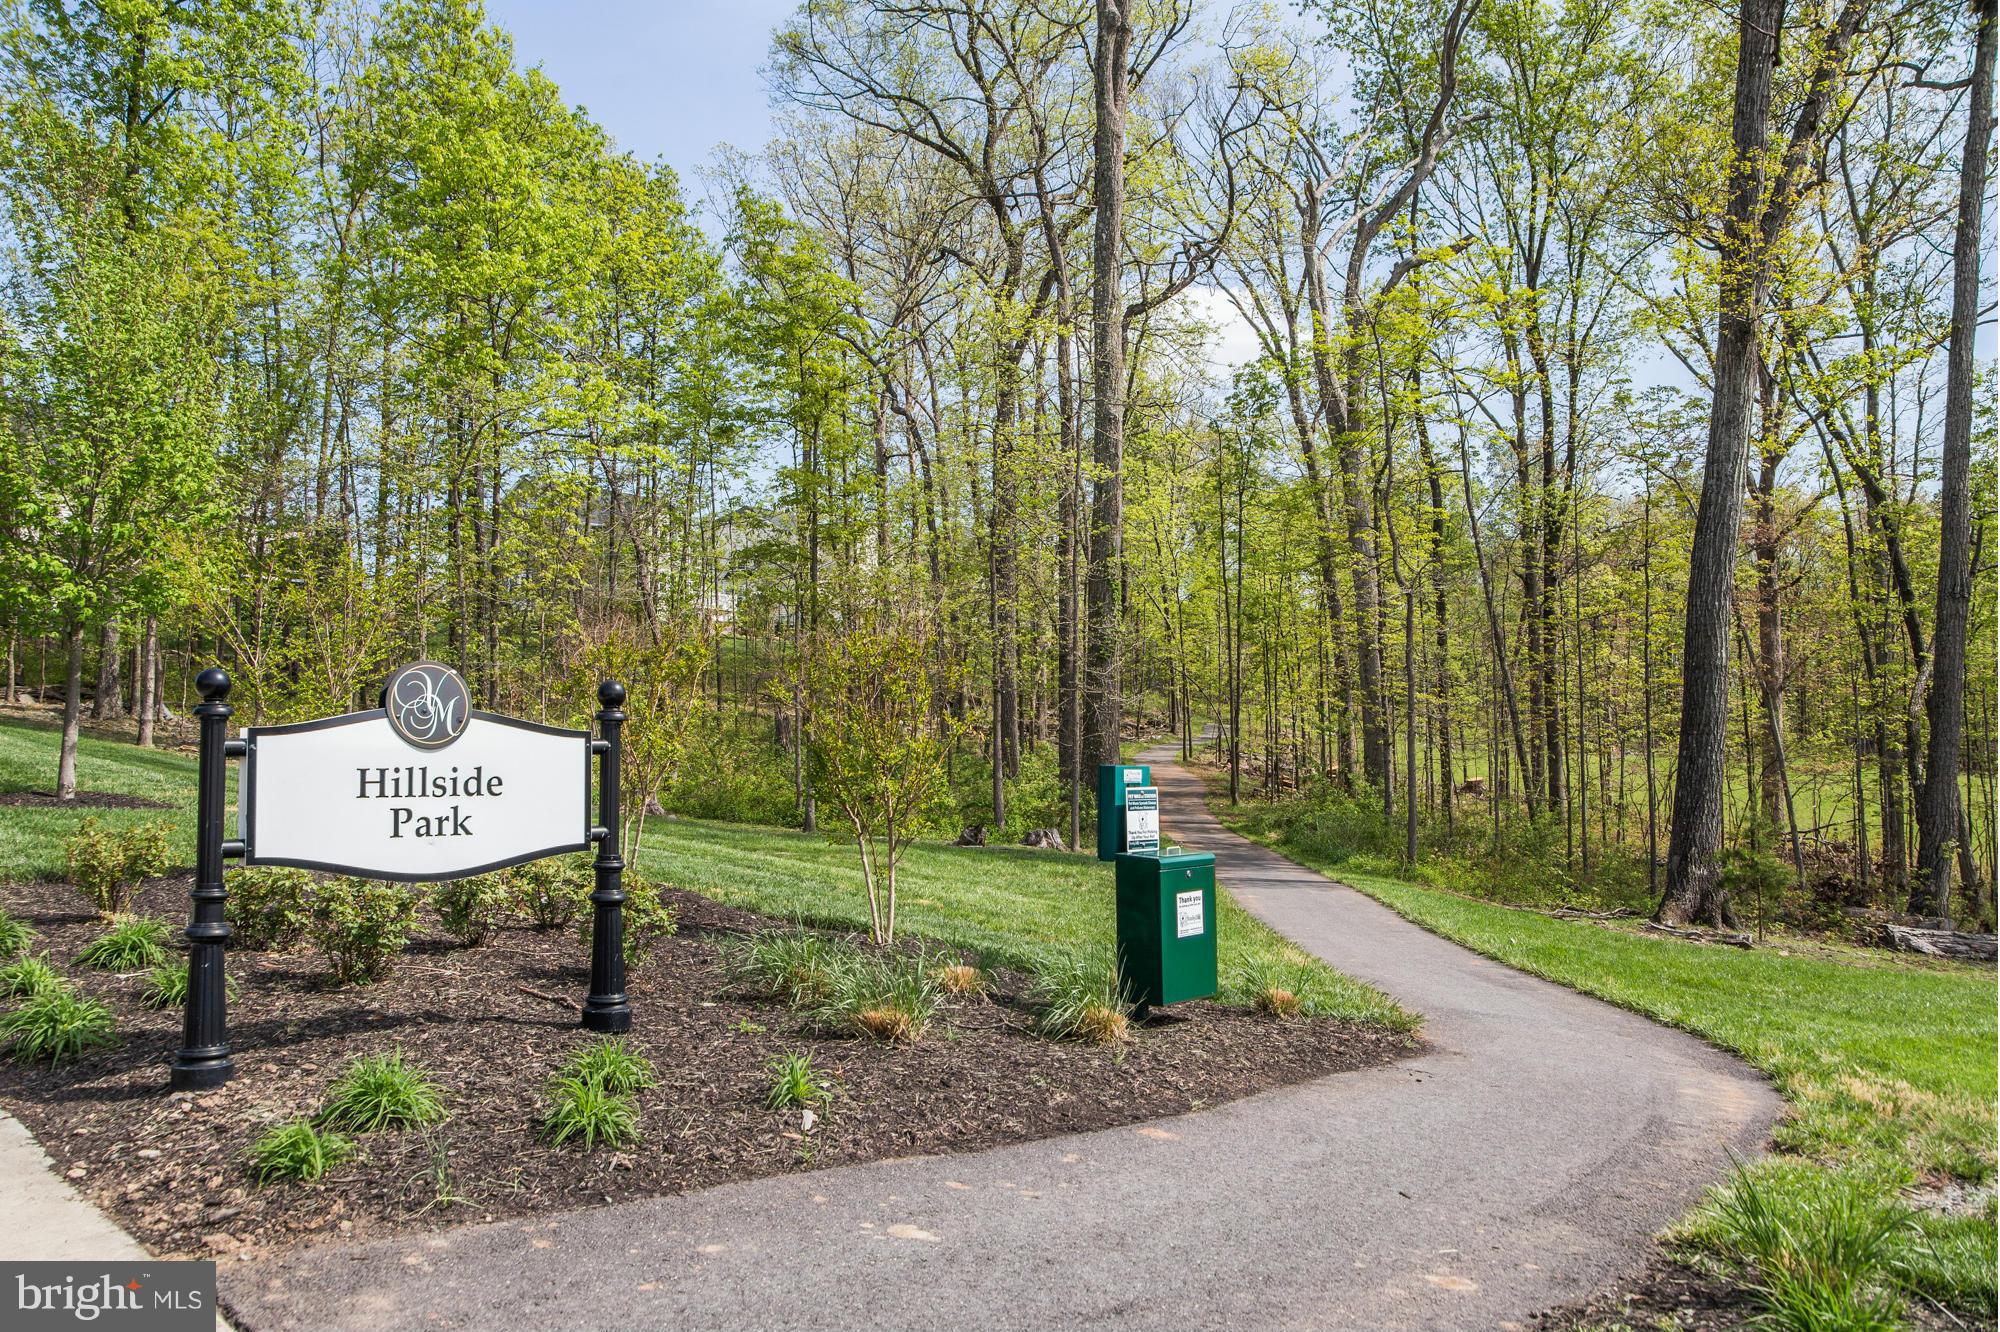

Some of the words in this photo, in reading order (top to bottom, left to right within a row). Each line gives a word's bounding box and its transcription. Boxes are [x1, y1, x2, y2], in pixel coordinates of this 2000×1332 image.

[356, 766, 503, 799] Hillside
[390, 805, 473, 839] Park
[1179, 896, 1192, 904] Thank
